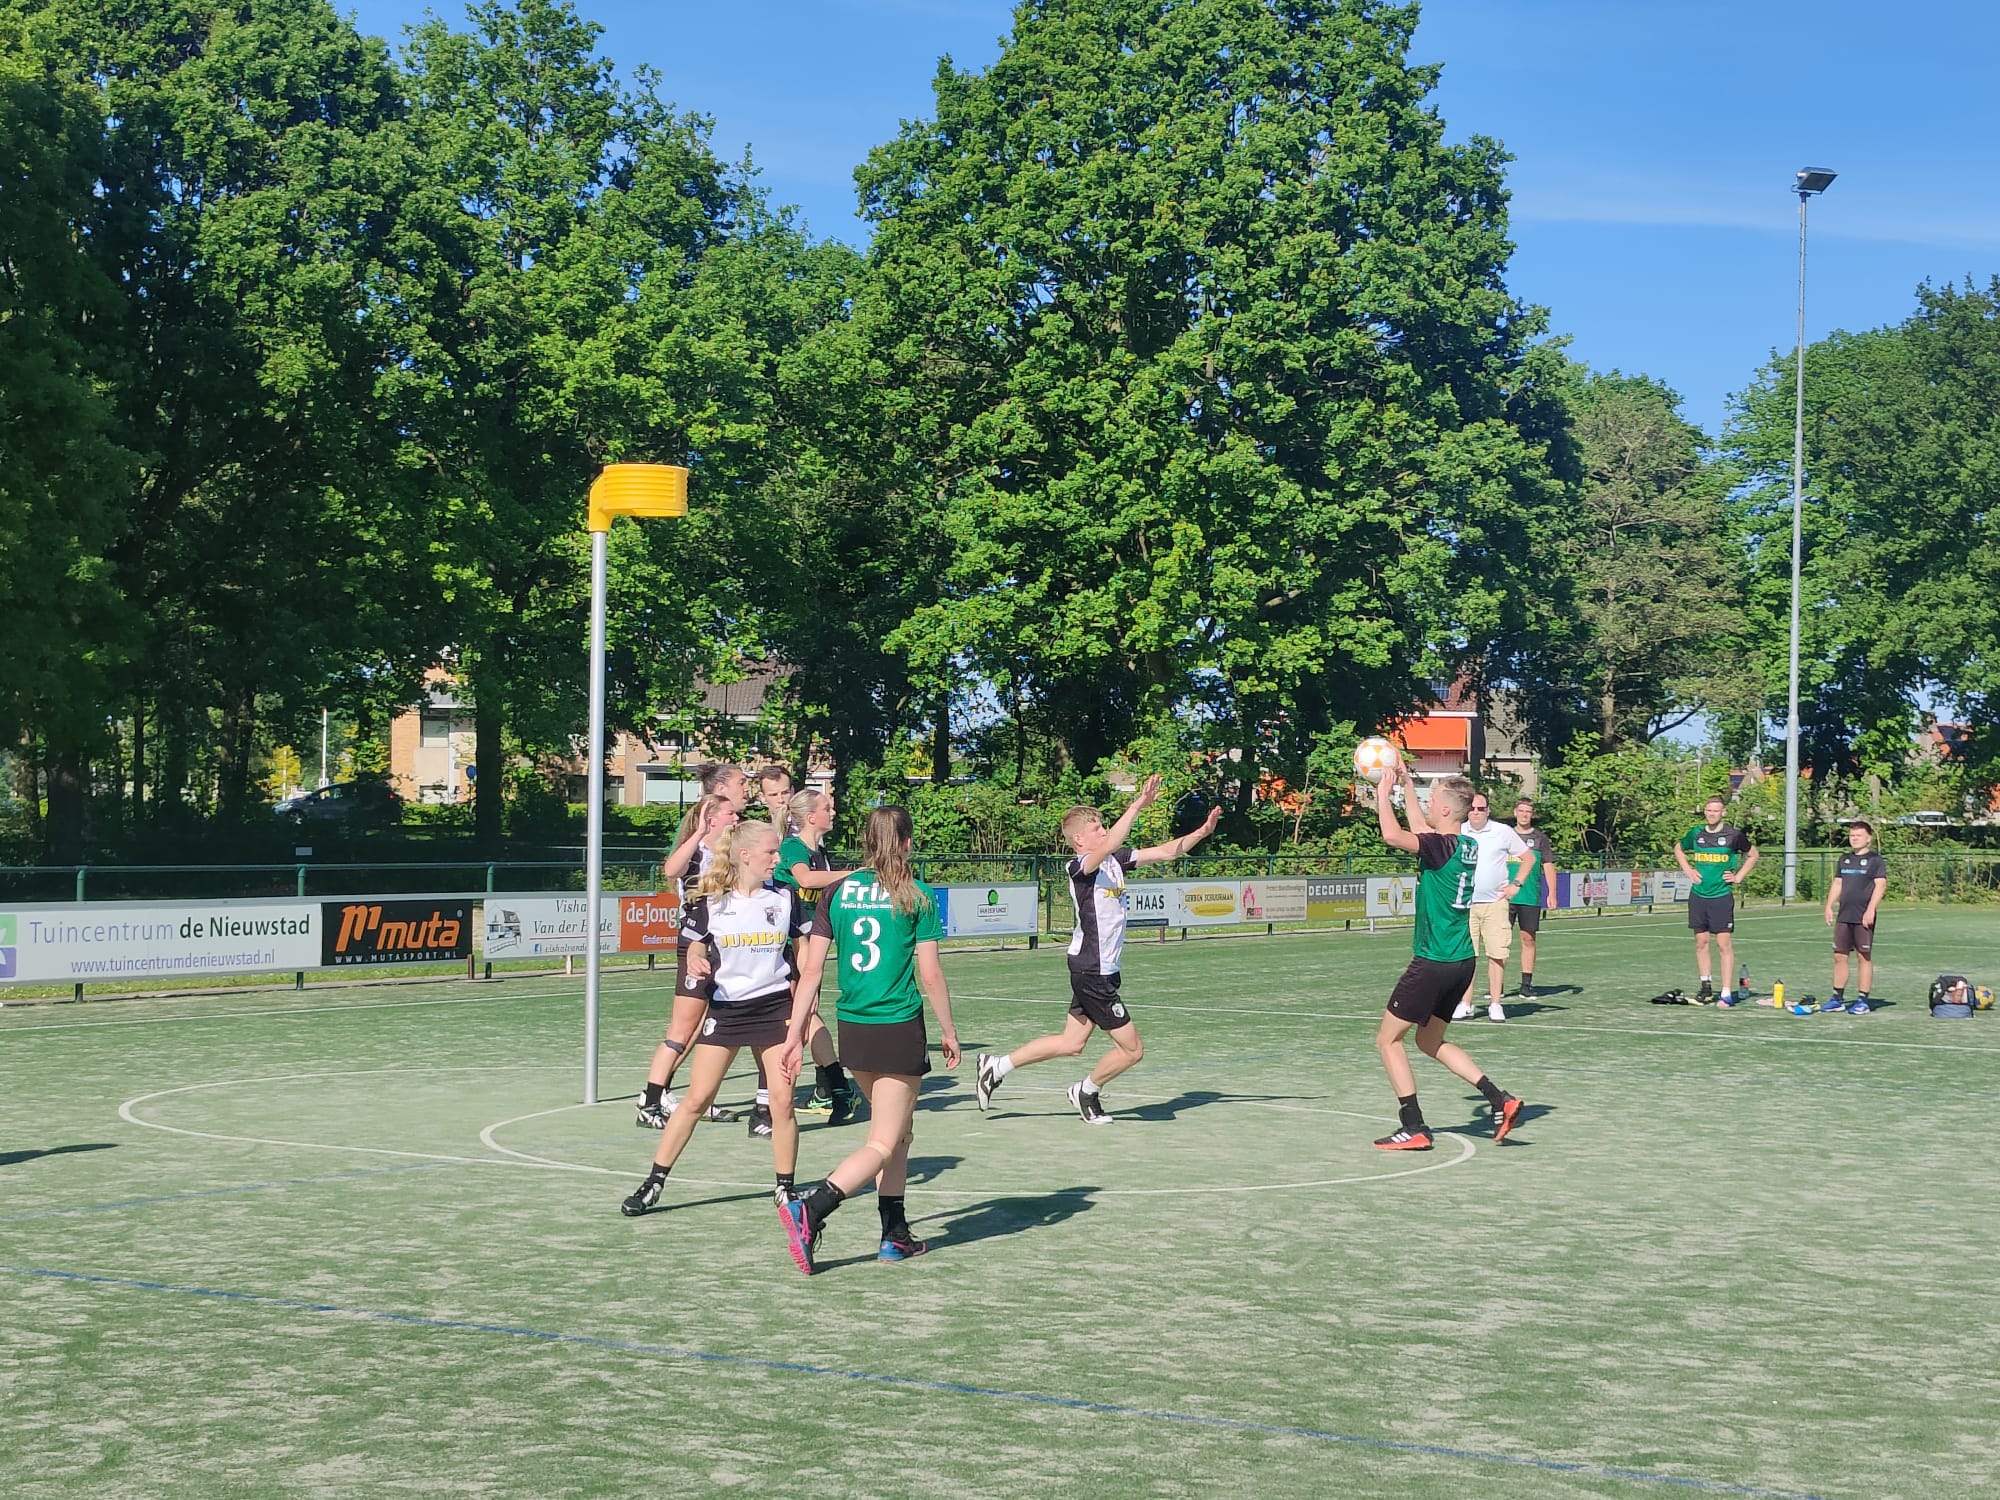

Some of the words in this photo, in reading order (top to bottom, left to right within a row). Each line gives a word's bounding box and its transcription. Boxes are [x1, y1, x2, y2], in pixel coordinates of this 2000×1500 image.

[1308, 884, 1366, 896] DECORETTE
[556, 899, 587, 913] Visha
[1136, 895, 1165, 910] HAAS
[29, 921, 174, 944] Tuincentrum
[180, 917, 204, 938] de
[209, 913, 310, 938] Nieuwstad
[376, 911, 461, 950] muta
[533, 920, 554, 934] Van
[558, 919, 578, 934] der
[720, 931, 787, 949] JUMBO
[851, 916, 881, 972] 3
[71, 948, 276, 973] www.tuincentrumdenieuwstad.nl
[334, 950, 458, 964] WWW.MUTASPORT.NL
